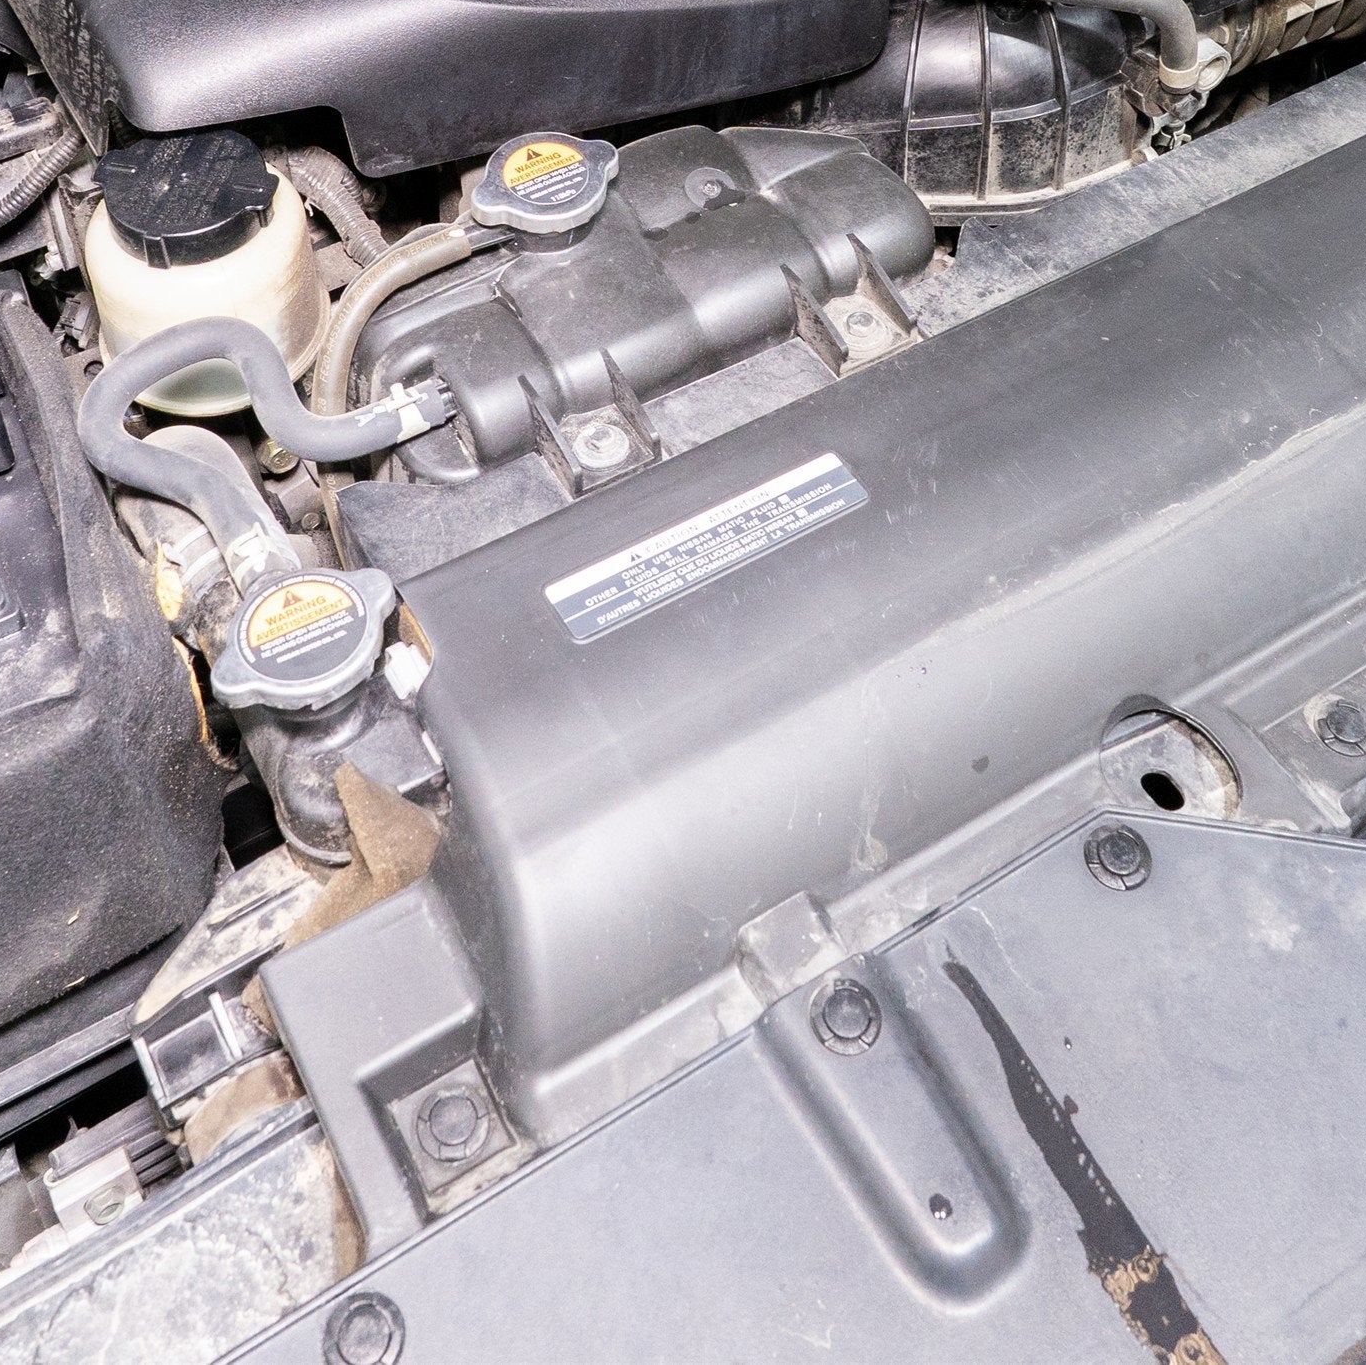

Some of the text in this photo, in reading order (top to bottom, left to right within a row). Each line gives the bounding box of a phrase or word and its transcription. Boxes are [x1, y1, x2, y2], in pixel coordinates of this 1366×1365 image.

[509, 154, 576, 184] AVERTISSEMENT
[515, 152, 561, 173] WARNING
[583, 586, 618, 607] OTHER
[624, 566, 660, 587] FLUIDS
[665, 551, 690, 567] WILL
[694, 529, 735, 553] DAMAGE
[741, 517, 761, 530] THE
[765, 482, 833, 518] TRANSMISSION
[596, 598, 641, 625] D'AUTRES
[641, 577, 684, 602] LIQUIDES
[684, 535, 770, 581] ENDOMMAGERAIENT
[769, 528, 784, 539] LA
[784, 498, 846, 532] TRANSMISSION
[620, 562, 647, 580] ONLY
[651, 550, 673, 565] USE
[676, 531, 713, 552] NISSAN
[716, 515, 746, 533] MATIC
[749, 500, 777, 517] FLUID
[676, 562, 696, 576] QUE
[694, 555, 710, 567] DU
[707, 540, 741, 560] LIQUIDE
[739, 528, 766, 545] MATIC
[763, 513, 795, 533] NISSAN
[256, 599, 344, 641] AVERTISSEMENT
[265, 596, 327, 626] WARNING
